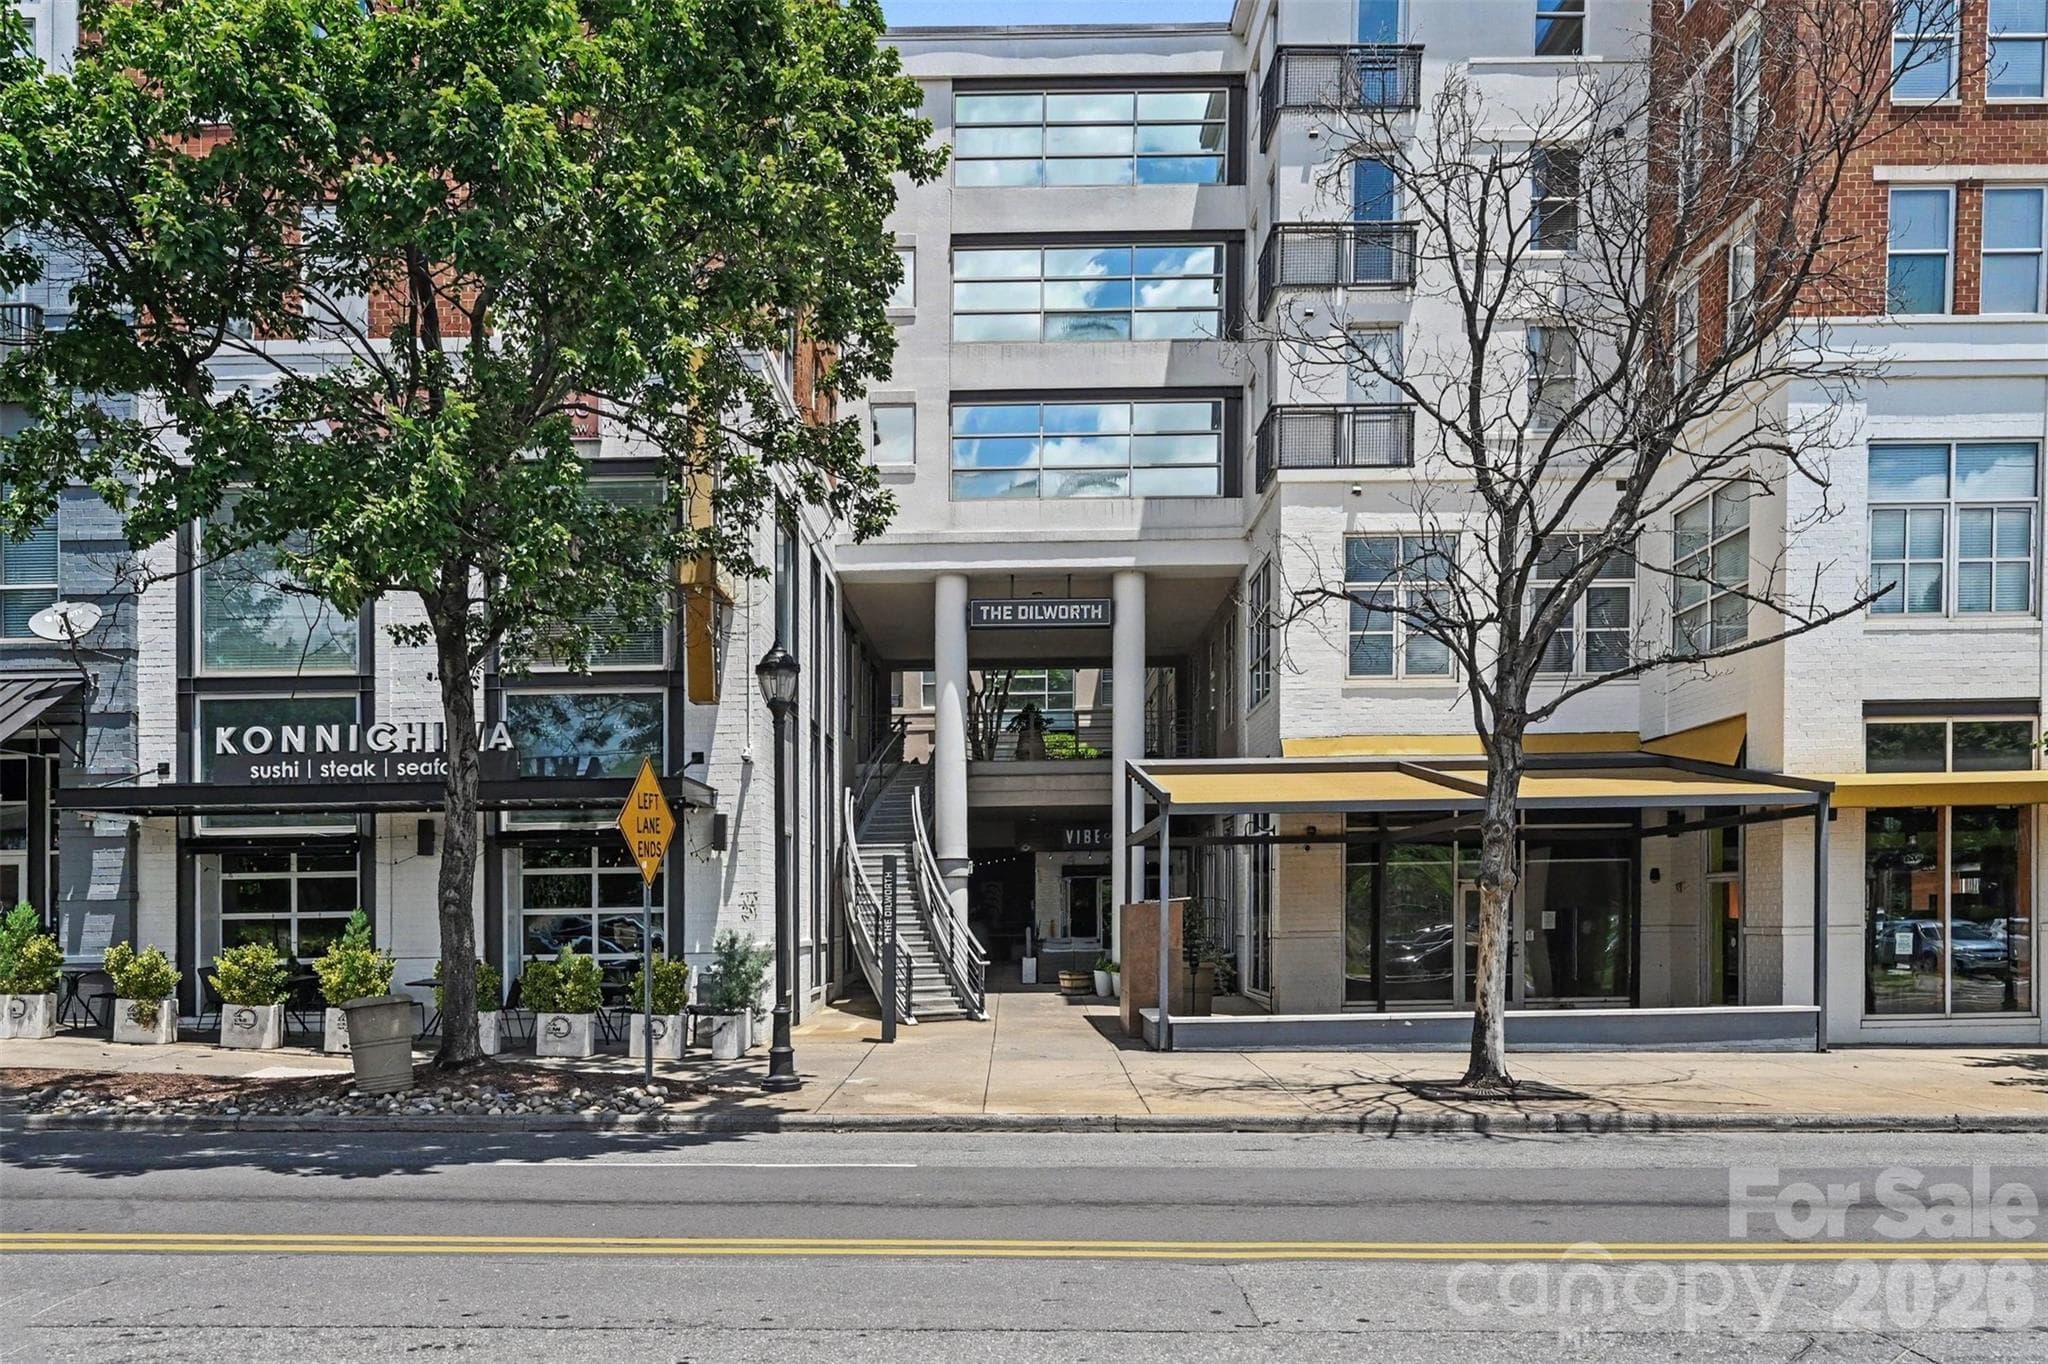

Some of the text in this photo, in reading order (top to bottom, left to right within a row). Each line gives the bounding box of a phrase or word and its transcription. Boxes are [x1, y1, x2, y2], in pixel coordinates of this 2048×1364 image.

[980, 604, 1103, 621] THE DILWORTH
[215, 721, 515, 755] KONNICHIA
[249, 760, 300, 779] sushi
[320, 758, 377, 778] steak
[637, 792, 660, 811] LEFT
[636, 816, 662, 835] LANE
[1065, 828, 1101, 845] VIBE
[637, 840, 662, 859] ENDS
[884, 871, 893, 945] THE DILWORTH
